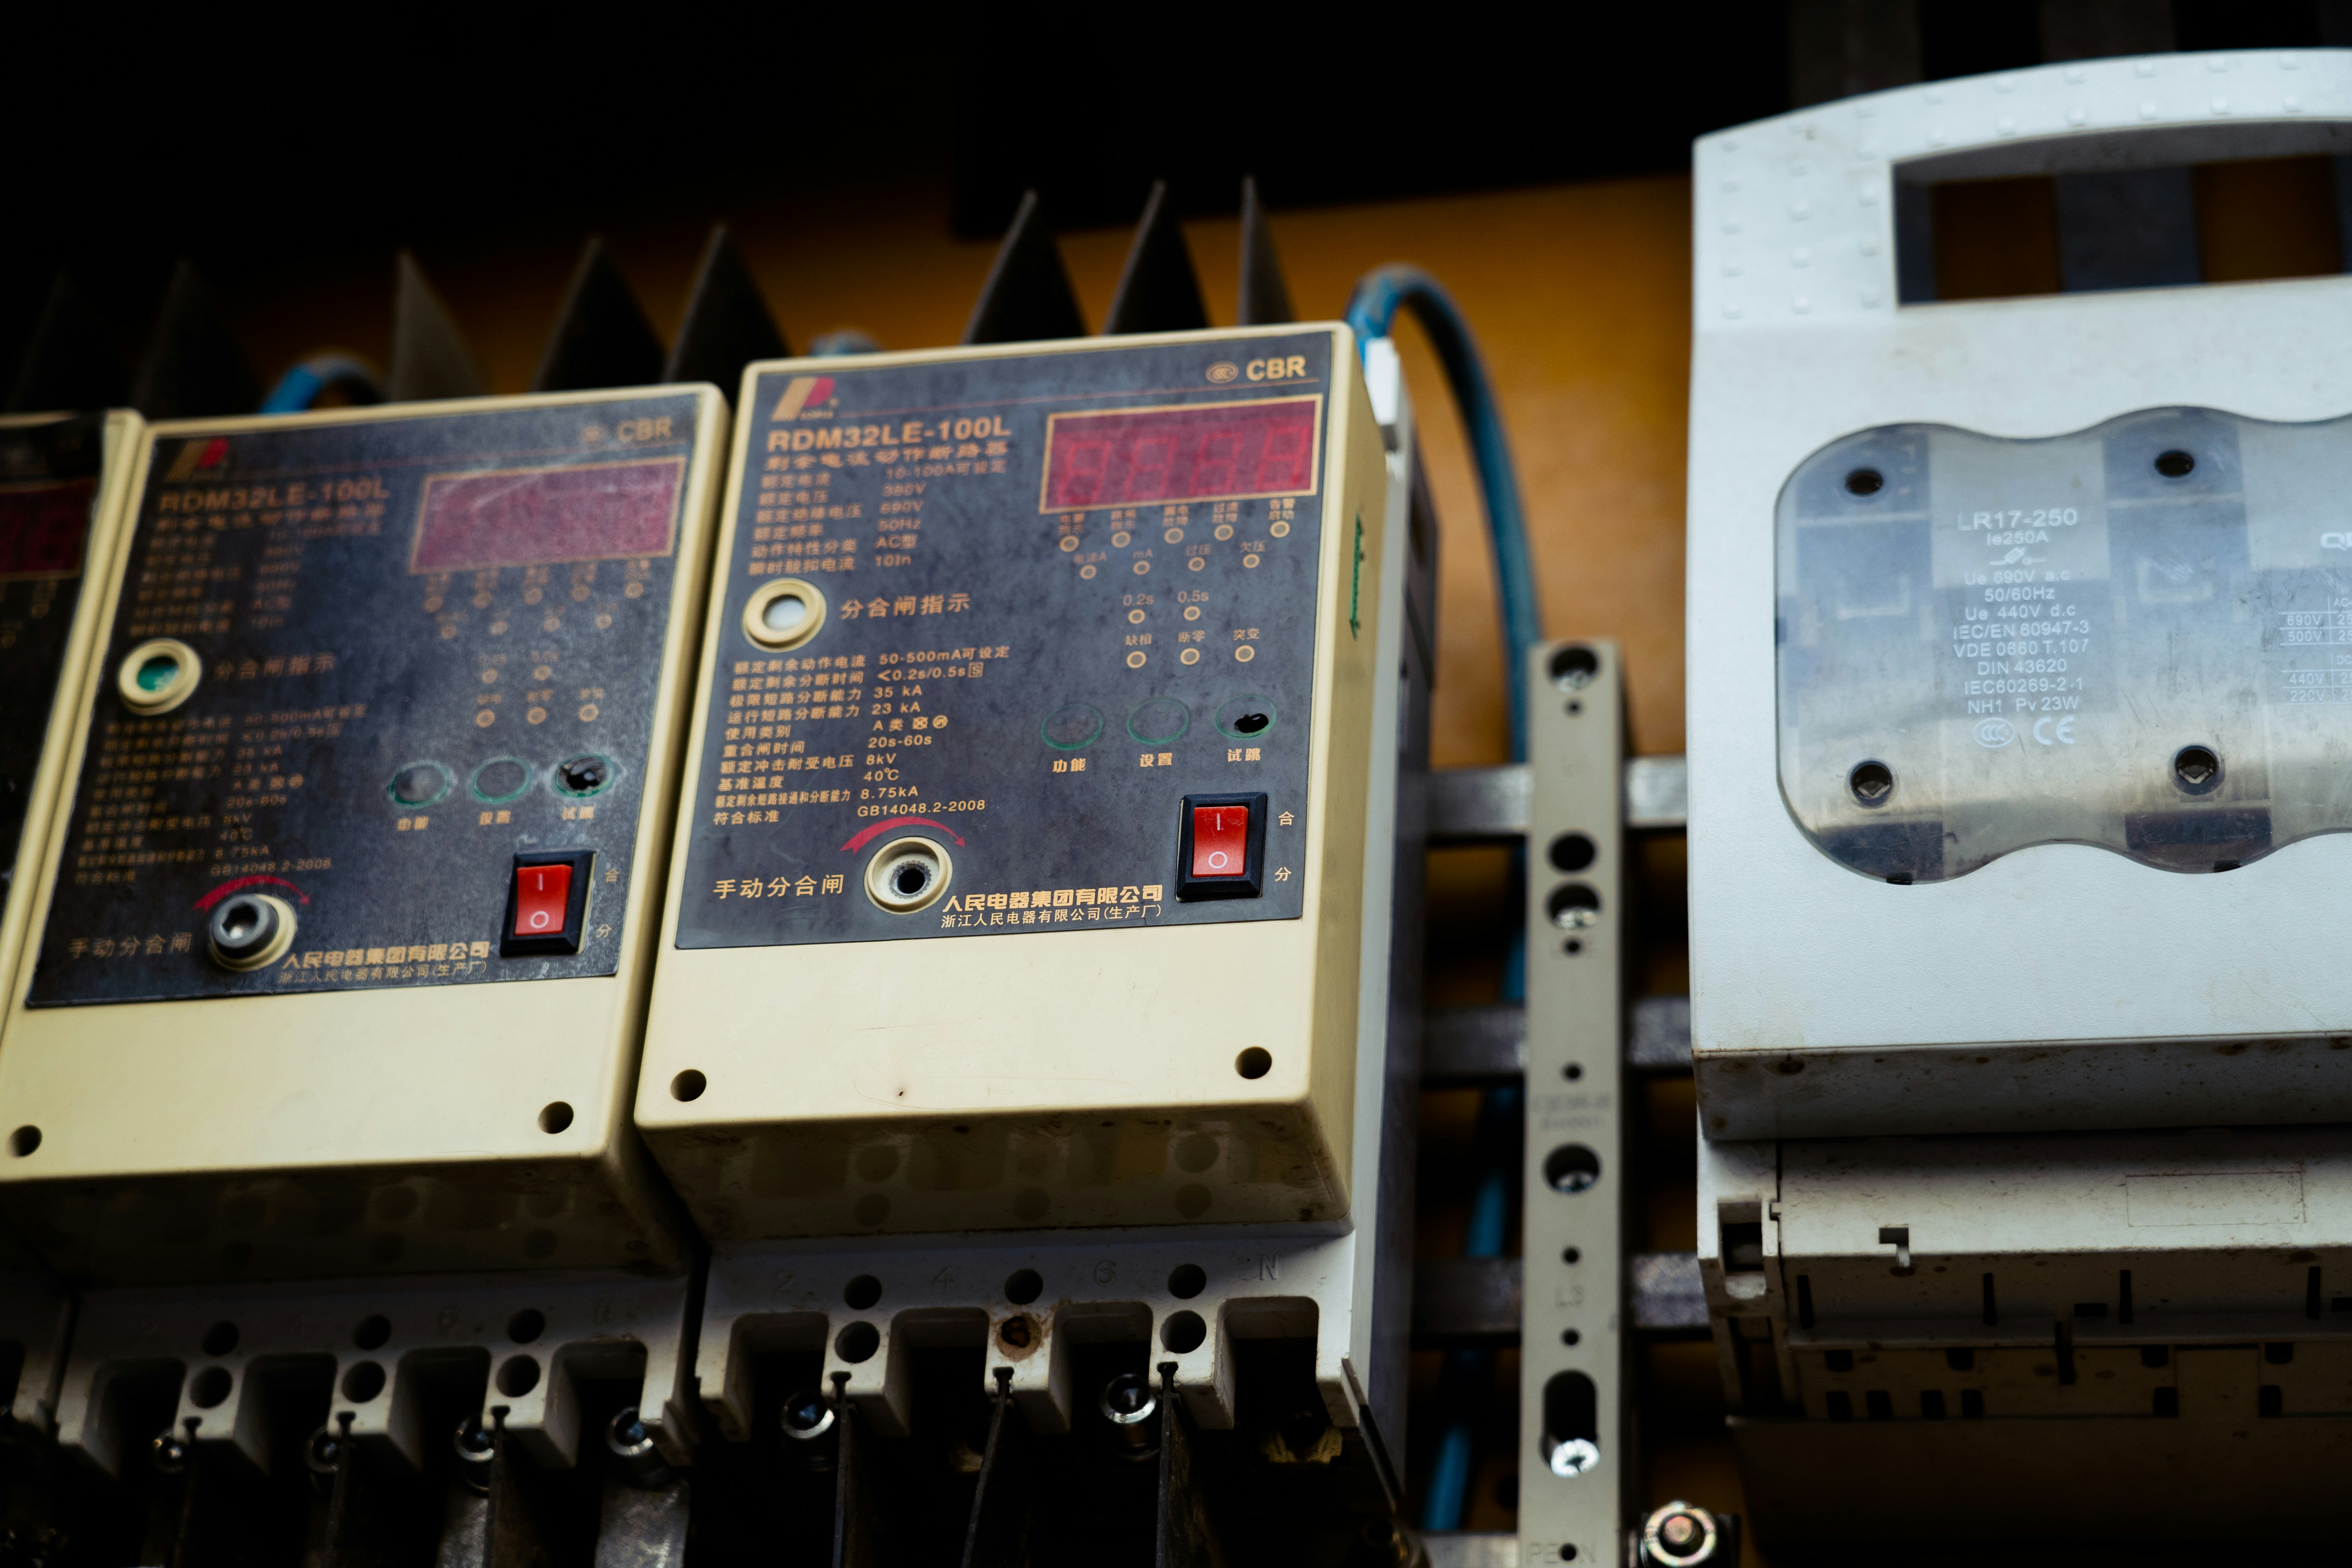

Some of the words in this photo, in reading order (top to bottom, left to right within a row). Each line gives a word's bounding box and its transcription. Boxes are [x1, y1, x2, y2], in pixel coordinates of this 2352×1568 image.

[1246, 355, 1306, 381] CBR
[617, 416, 672, 443] CBR
[768, 416, 1011, 452] RDM32LE-100L
[880, 500, 924, 515] 690V
[878, 519, 921, 532] 50Hz
[1958, 507, 2077, 531] LR17-250
[876, 534, 917, 549] AC型
[1240, 541, 1266, 553] 欠压
[1965, 572, 1986, 585] Ue
[1993, 569, 2035, 583] 690V
[1123, 594, 1154, 606] 0.2s
[1178, 591, 1209, 603] 0.5s
[1984, 586, 2055, 602] 50/60Hz
[841, 593, 971, 620] 分合闸指示
[1965, 607, 1988, 621] Ue
[1997, 605, 2040, 619] 440V
[2287, 614, 2321, 626] 690V
[1178, 630, 1205, 643] 断零
[1233, 628, 1260, 641] 突变
[1954, 624, 2015, 640] IEC/EN
[2020, 619, 2089, 637] 60947-3
[2288, 630, 2322, 642] 500V
[1125, 633, 1152, 646] 缺相
[1954, 642, 1991, 658] VDE
[1996, 641, 2038, 656] 0660
[2042, 638, 2089, 654] T.107
[734, 655, 866, 675] 额定剩余动作电流
[879, 646, 1010, 666] 50-500mA可设定
[1978, 661, 2009, 676] DIN
[2014, 658, 2067, 674] 43620
[732, 671, 863, 691] 额定剩余分断时间
[1965, 677, 2083, 695] IEC60269-2-1
[2289, 673, 2324, 685] 440V
[730, 688, 861, 708] 极限短路分断能力
[873, 686, 894, 699] 35
[902, 684, 922, 697] kA
[1968, 699, 2002, 714] NH1
[2016, 697, 2036, 712] Pv
[2041, 695, 2079, 711] 23W
[2290, 689, 2325, 702] 220V
[727, 705, 859, 725] 运行短路分断能力
[871, 703, 892, 715] 23
[900, 701, 920, 713] kA
[725, 724, 791, 741] 使用类别
[889, 718, 904, 732] 类
[2033, 715, 2075, 746] CE
[723, 741, 805, 758] 重合闸时间
[867, 734, 932, 749] 20s-60s
[1227, 748, 1261, 762] 试跳
[720, 755, 855, 774] 额定冲击耐受电压
[866, 753, 897, 765] 8kV
[1053, 758, 1086, 773] 功能
[1140, 753, 1173, 768] 设置
[718, 775, 784, 791] 基准温度
[860, 786, 918, 800] 8.75kA
[714, 809, 779, 826] 符合标准
[858, 800, 985, 817] GB14048.2-2008
[1278, 810, 1295, 826] 合
[605, 869, 619, 883] 合
[1274, 867, 1292, 882] 分
[713, 874, 845, 899] 手动分合闸
[943, 884, 1163, 912] 人民电器集团有限公司
[941, 904, 1162, 928] 浙江人民电器有限公司(生产厂)
[596, 924, 612, 939] 分
[67, 931, 192, 960] 手动分合闸
[282, 941, 490, 970] 人民电器集团有限公司
[1093, 1260, 1116, 1285] 6
[1258, 1252, 1279, 1281] N
